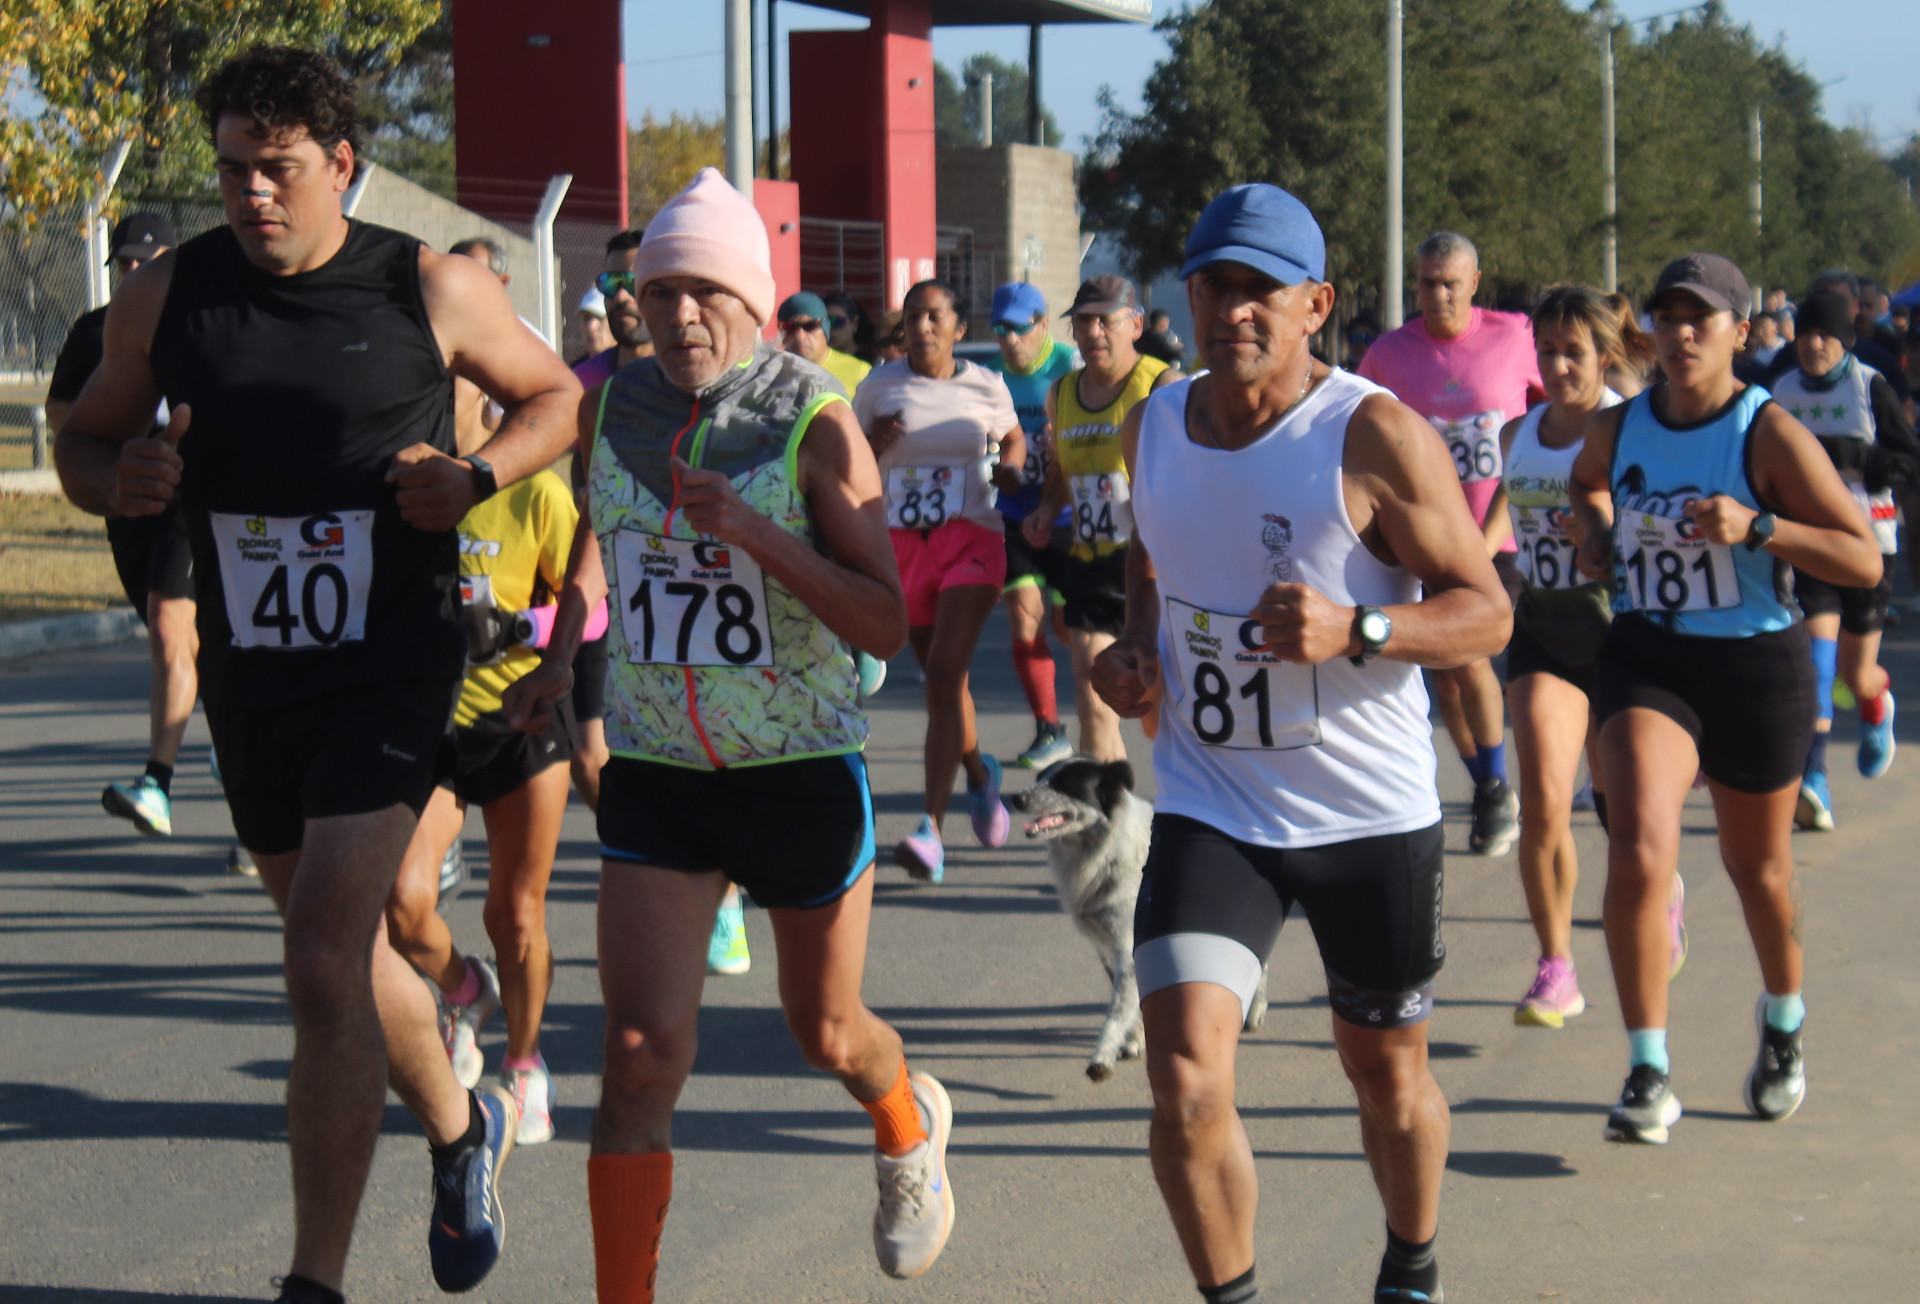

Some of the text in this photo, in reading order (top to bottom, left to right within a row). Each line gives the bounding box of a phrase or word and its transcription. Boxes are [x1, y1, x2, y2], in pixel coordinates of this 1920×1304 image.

[1449, 438, 1498, 481] 36
[899, 488, 946, 528] 83
[1078, 501, 1118, 543] 84
[252, 563, 349, 646] 40
[1627, 546, 1719, 611] 181
[629, 578, 762, 665] 178
[1193, 661, 1275, 748] 81
